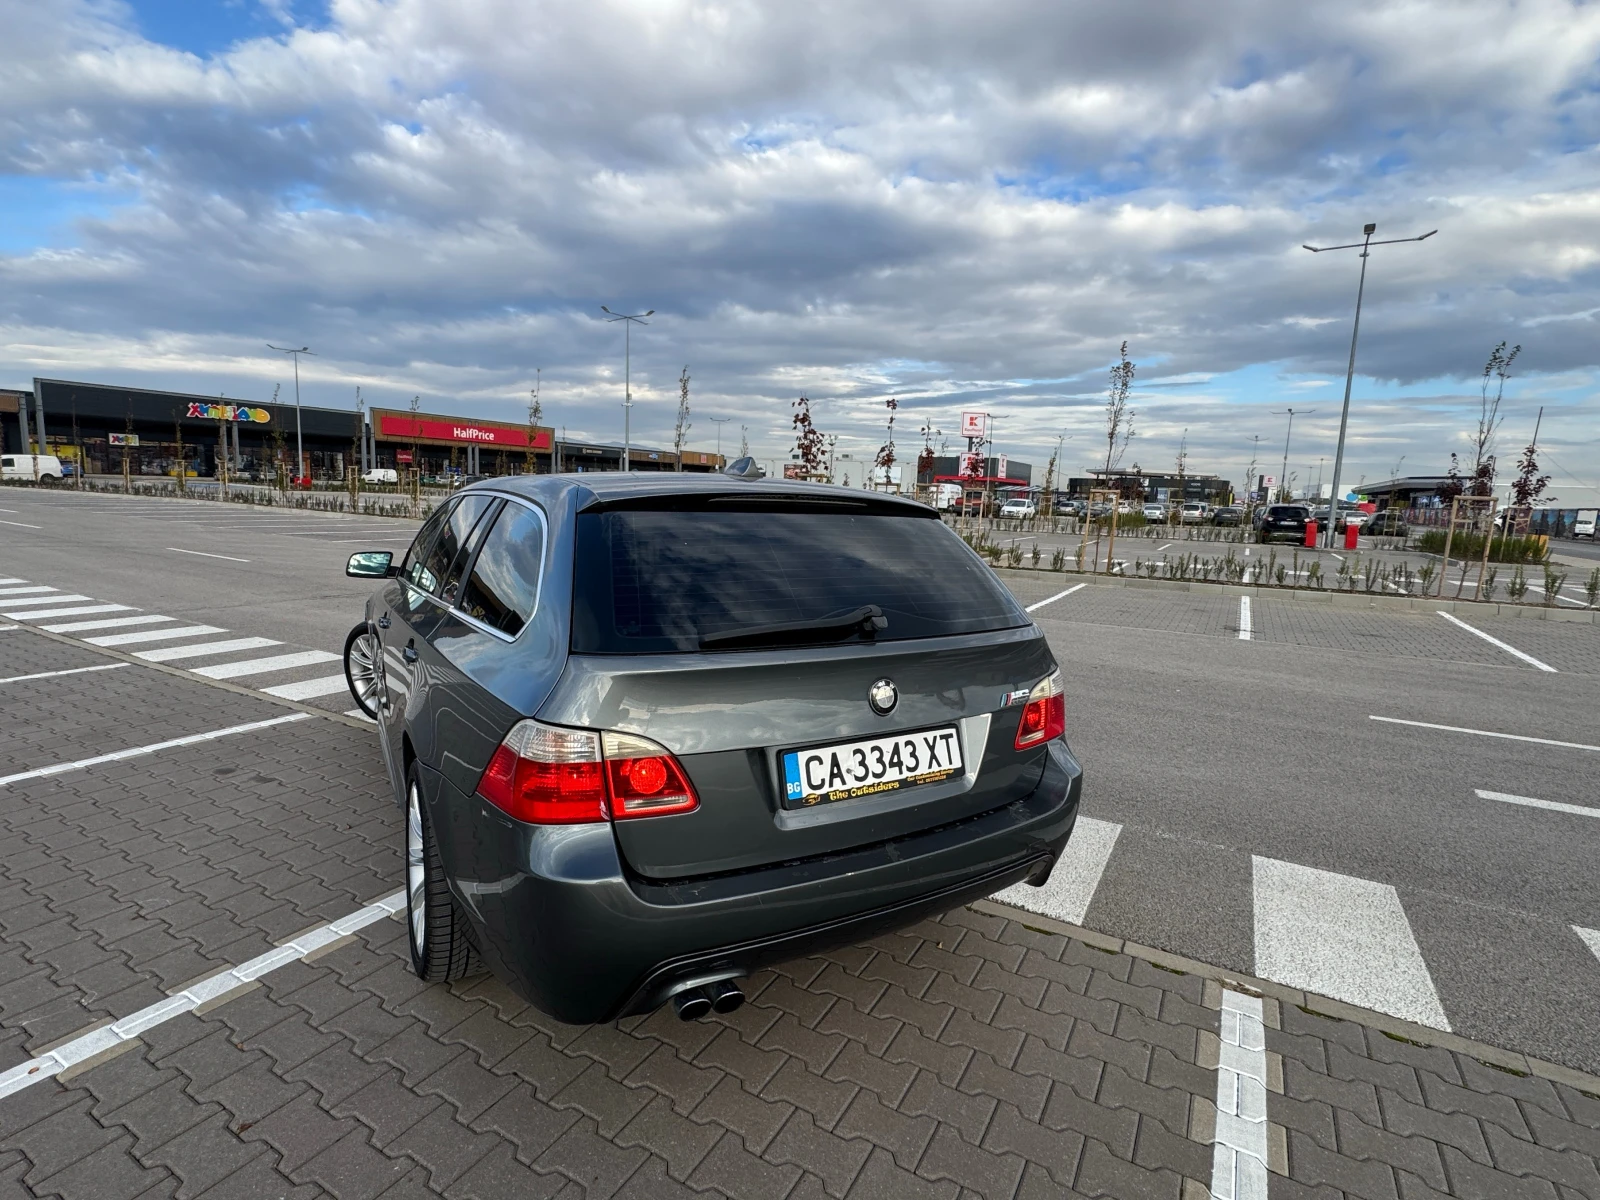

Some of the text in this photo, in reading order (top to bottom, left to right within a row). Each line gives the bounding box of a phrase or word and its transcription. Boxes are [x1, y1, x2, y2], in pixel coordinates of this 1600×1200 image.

[453, 427, 495, 441] HalfPrice
[805, 733, 954, 791] CA 3343 XT
[787, 781, 801, 795] BG
[828, 780, 900, 801] The Outsiders
